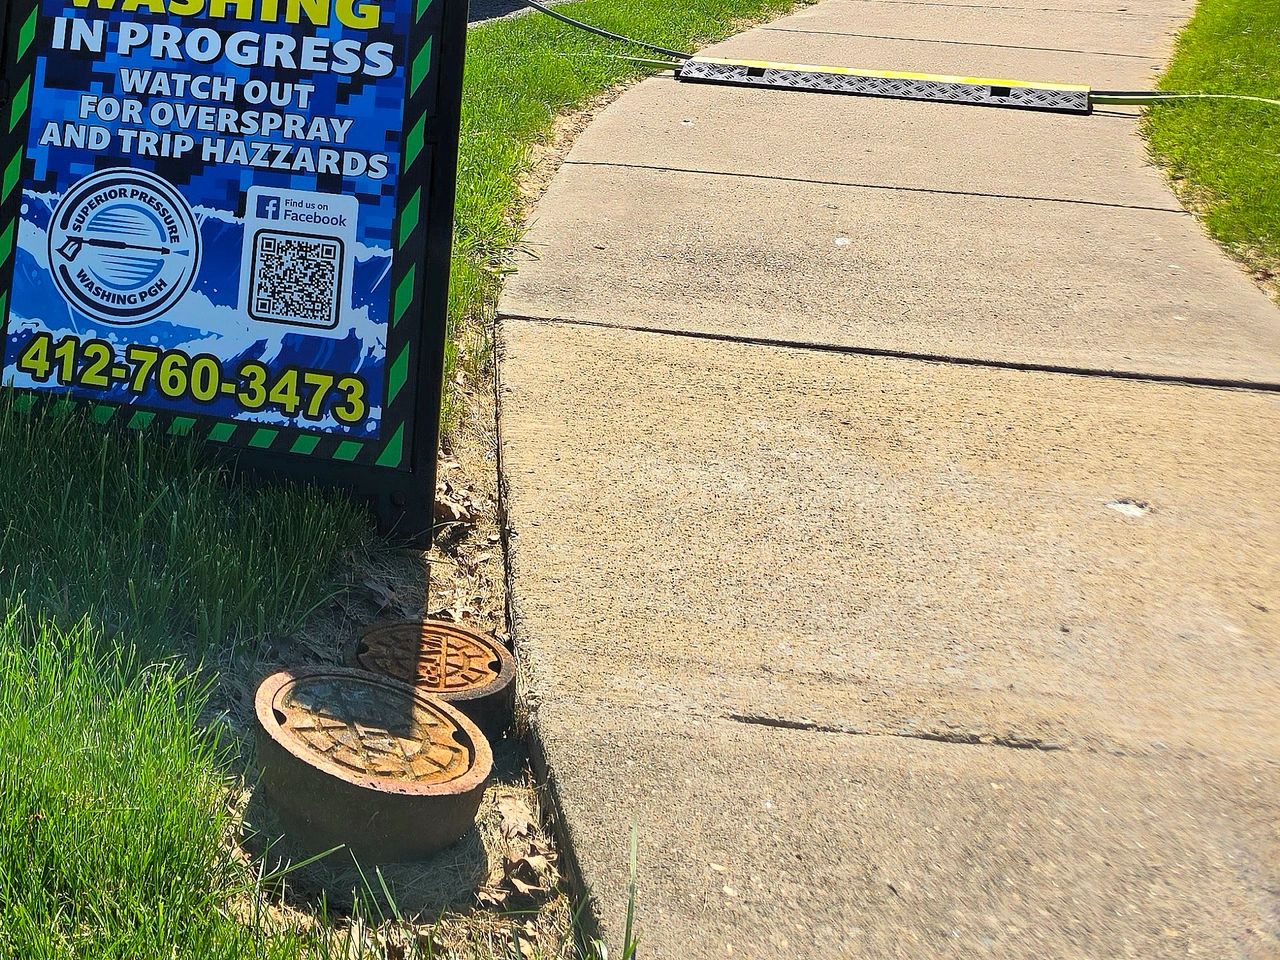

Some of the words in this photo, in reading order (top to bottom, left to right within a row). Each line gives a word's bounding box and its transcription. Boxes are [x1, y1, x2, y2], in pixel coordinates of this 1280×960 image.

[51, 17, 106, 52] IN
[117, 21, 395, 77] PROGRESS
[119, 68, 233, 102] WATCH
[243, 80, 315, 110] OUT
[78, 95, 143, 125] FOR
[150, 101, 355, 144] OVERSPRAY
[39, 122, 110, 151] AND
[117, 129, 196, 159] TRIP
[201, 137, 390, 179] HAZZARDS
[72, 187, 128, 233] SUPERIOR
[130, 189, 180, 244] PRESSURE
[283, 209, 347, 227] Facebook
[284, 198, 304, 208] Find
[317, 203, 329, 211] on
[76, 268, 138, 305] WASHING
[139, 278, 168, 302] PGH
[20, 336, 366, 422] 412-760-3473
